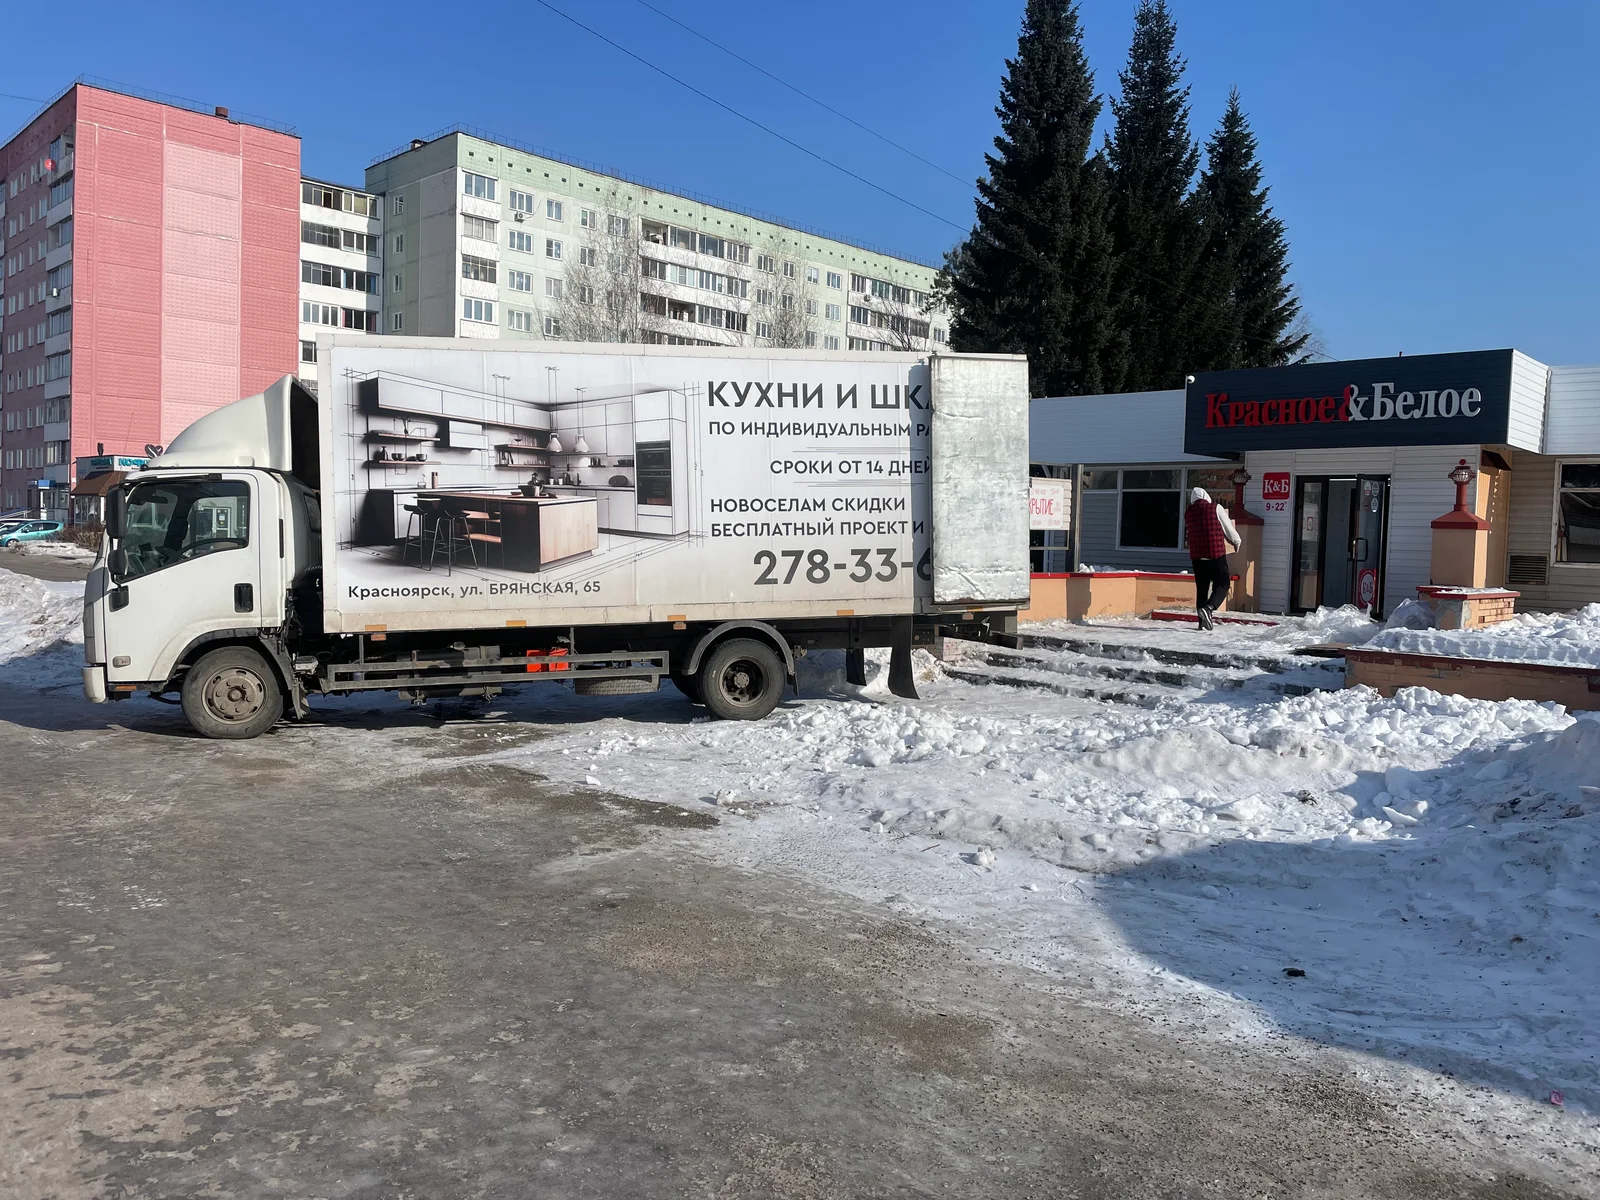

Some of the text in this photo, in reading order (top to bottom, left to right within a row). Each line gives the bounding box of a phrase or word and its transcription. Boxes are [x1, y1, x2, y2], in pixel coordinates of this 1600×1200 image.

[707, 381, 824, 408] КУХНИ
[836, 383, 858, 409] И
[708, 421, 736, 436] ПО
[741, 422, 911, 438] ИНДИВИДУАЛЬНЫМ
[769, 460, 833, 475] СРОКИ
[838, 460, 863, 474] ОТ
[866, 460, 884, 474] 14
[1263, 479, 1289, 494] К&Б
[710, 497, 906, 514] НОВОСЕЛАМ СКИДКИ
[710, 518, 924, 537] БЕСПЛАТНЫЙ ПРОЕКТ И
[348, 581, 601, 600] Красноярск, ул. БРЯНСКАЯ, 65
